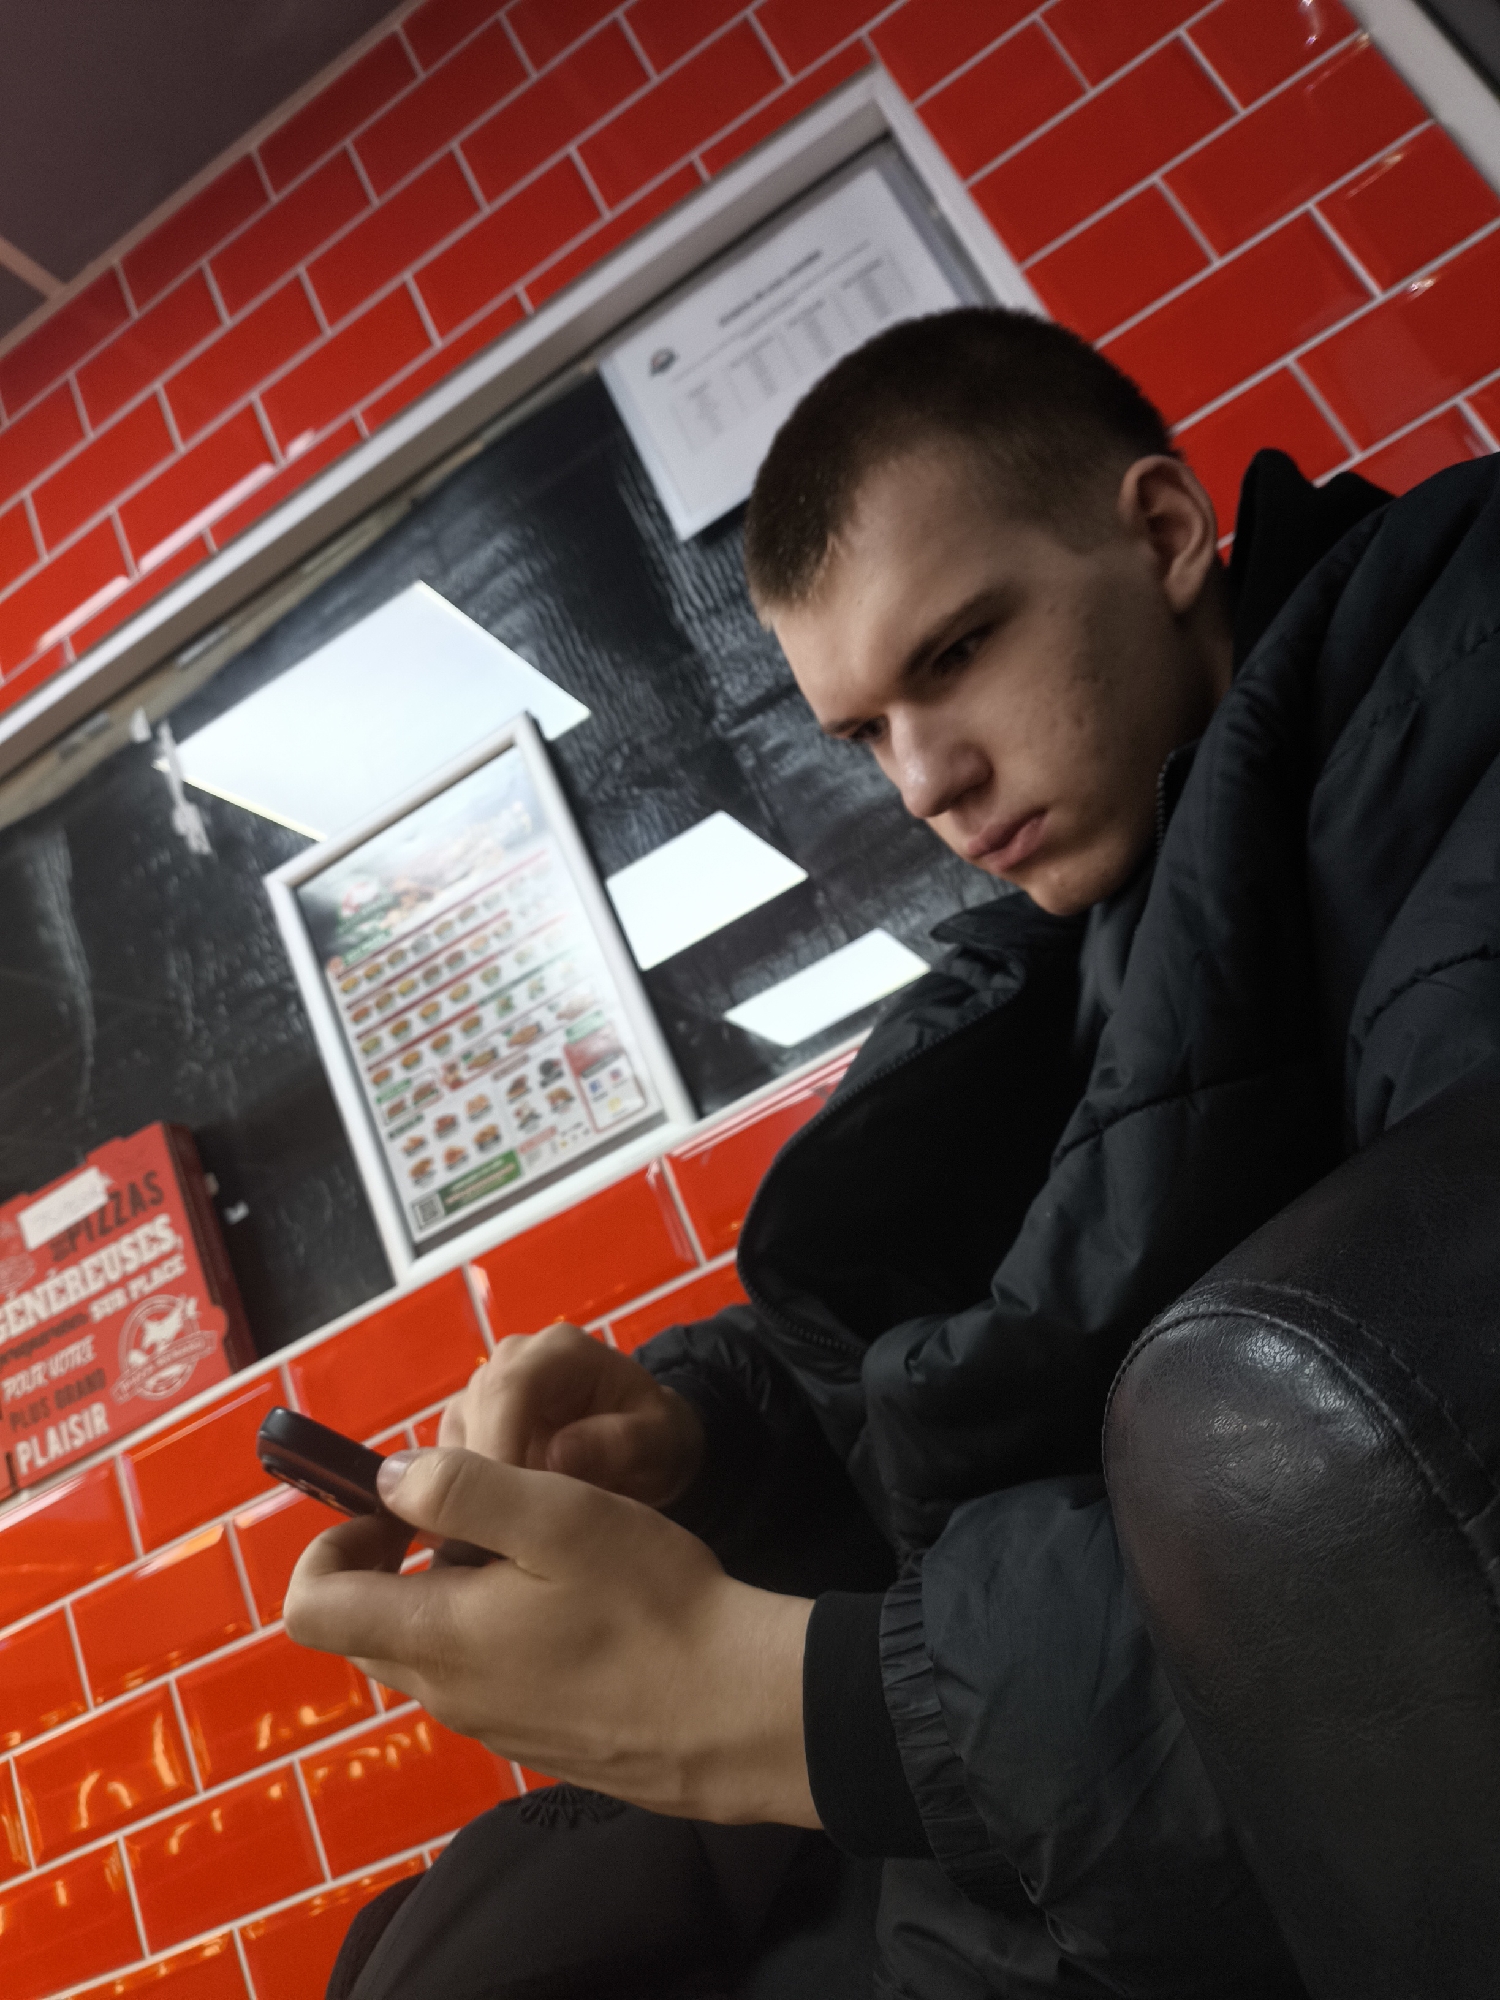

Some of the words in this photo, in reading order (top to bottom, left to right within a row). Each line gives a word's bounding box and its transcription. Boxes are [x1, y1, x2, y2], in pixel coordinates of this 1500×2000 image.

[128, 1253, 187, 1305] PLACE
[1, 1358, 52, 1401] POUR
[48, 1334, 98, 1380] VOTRE
[14, 1401, 110, 1477] PLAISIR
